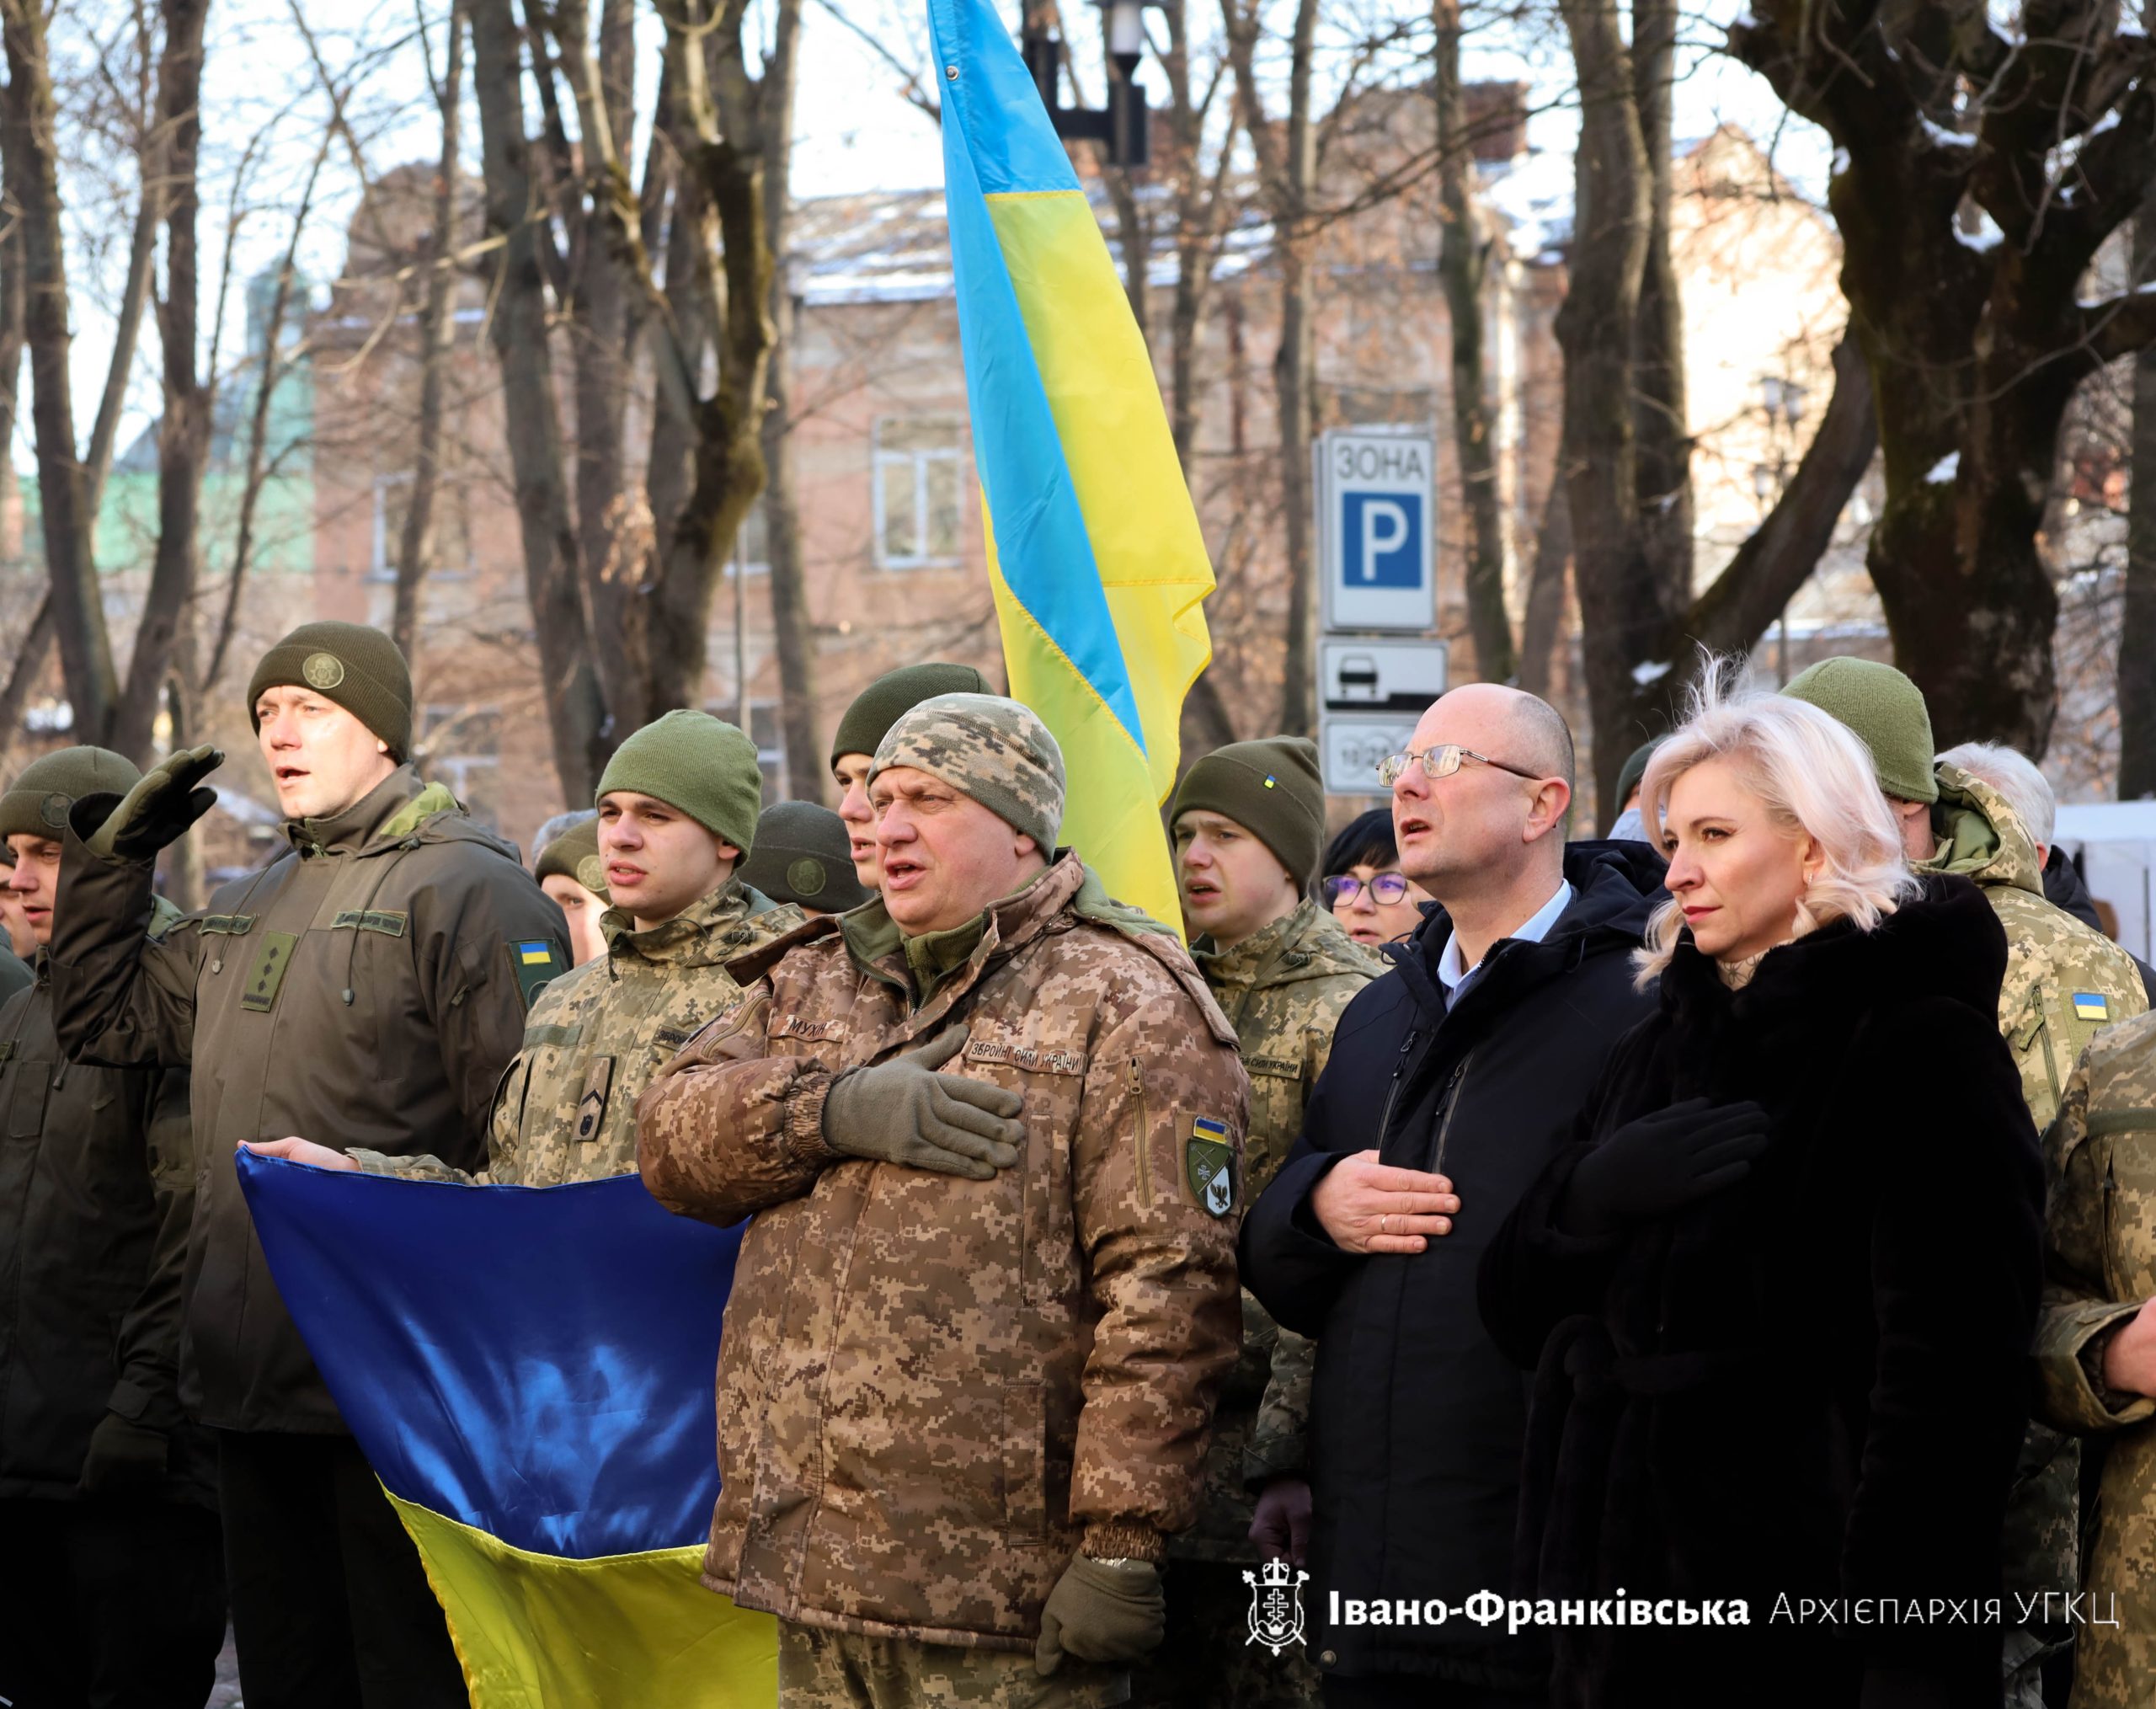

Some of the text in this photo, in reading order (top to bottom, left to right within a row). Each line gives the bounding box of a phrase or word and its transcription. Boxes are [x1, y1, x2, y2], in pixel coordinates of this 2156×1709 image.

[1337, 445, 1425, 480] ЗОНА
[1362, 499, 1409, 581] P
[788, 1017, 828, 1037] МУХІН
[971, 1043, 1080, 1071] ЗБРОЙНІ СИЛИ УКРАЇНИ
[1268, 1060, 1299, 1073] УКРАЇНИ
